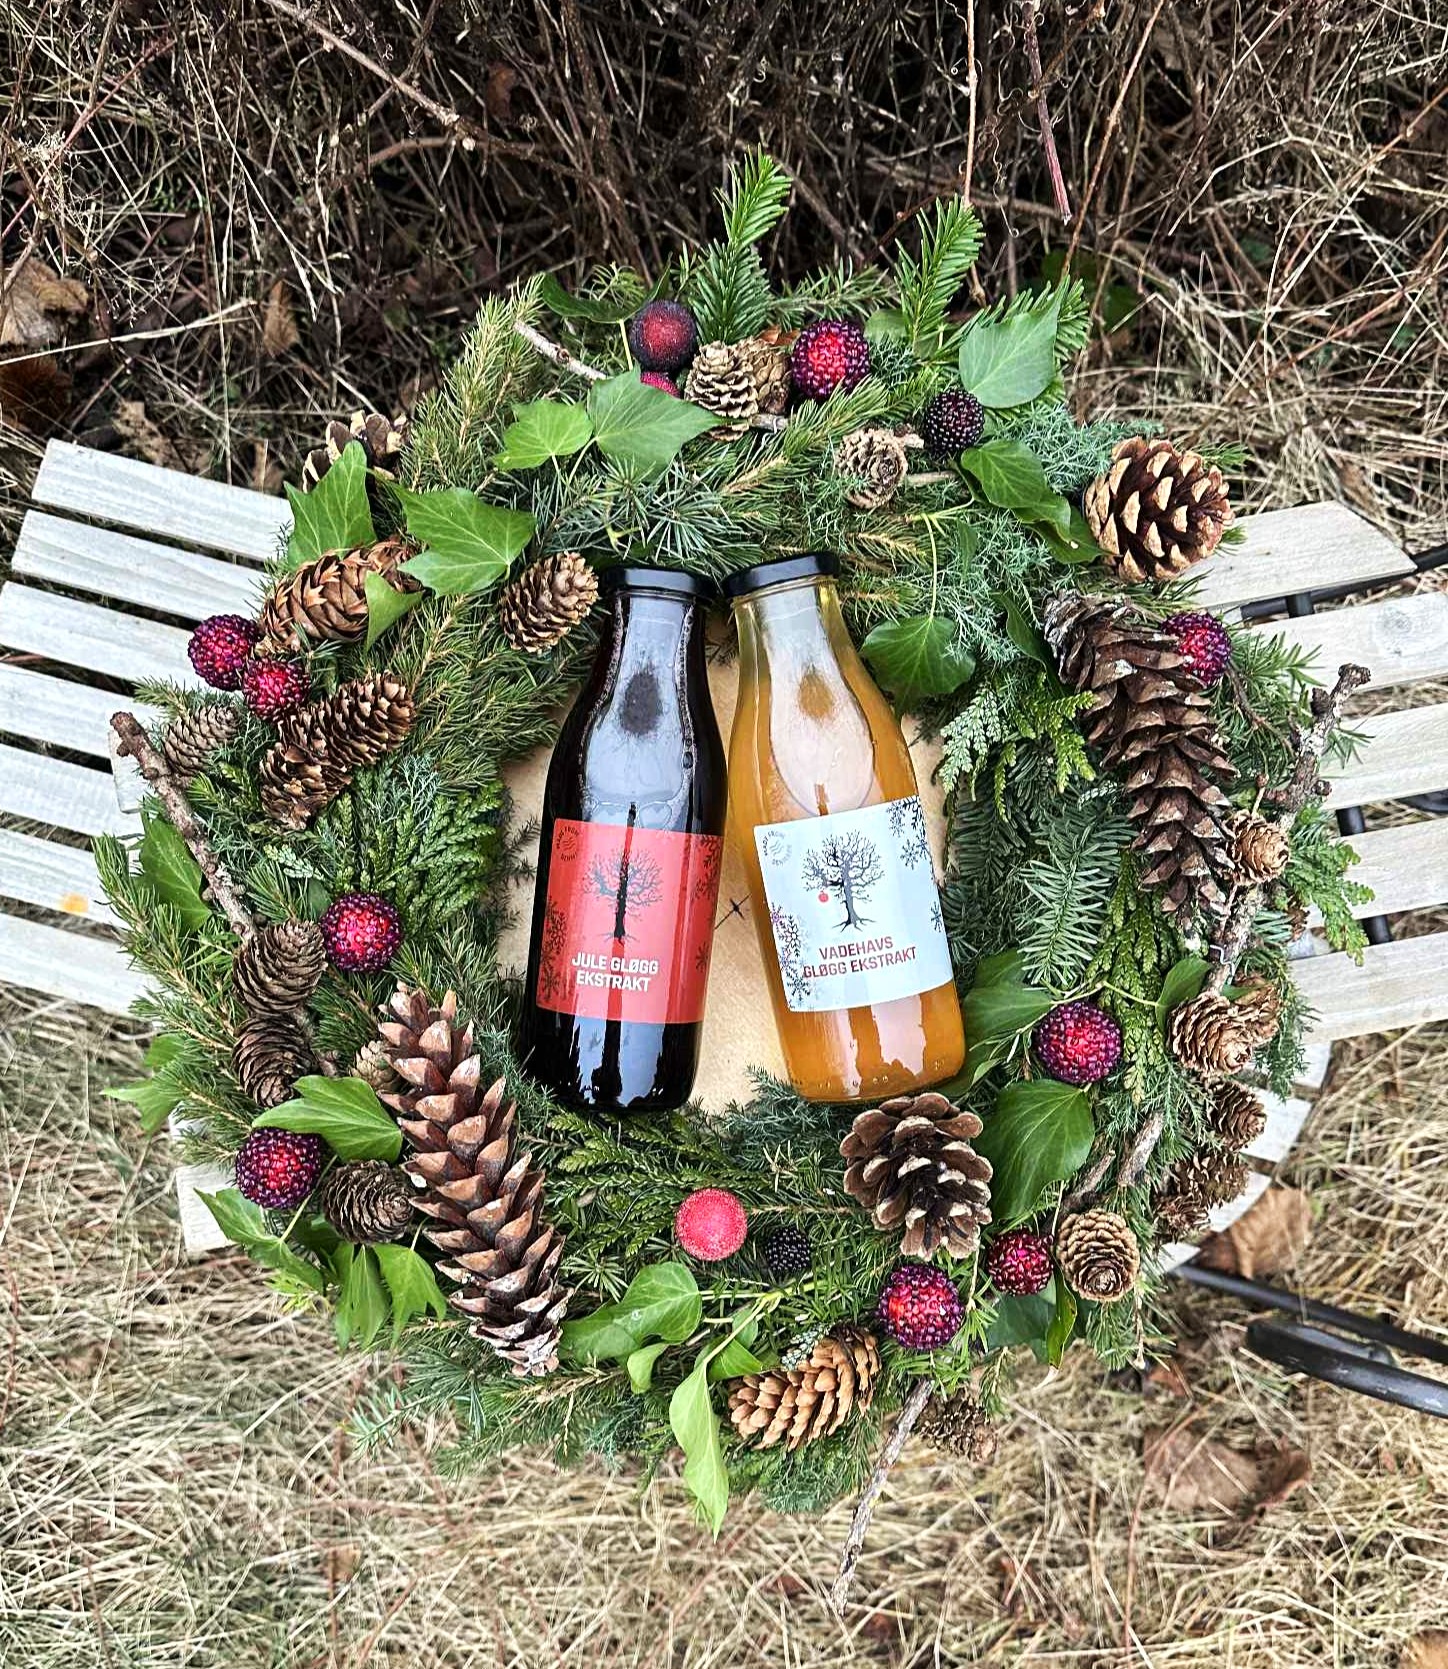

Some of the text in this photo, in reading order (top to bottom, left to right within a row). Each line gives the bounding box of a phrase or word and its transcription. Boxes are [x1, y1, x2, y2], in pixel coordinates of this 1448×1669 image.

[818, 935, 894, 961] VADEHAVS
[571, 951, 659, 975] JULE GLØGG
[802, 946, 917, 979] GLØGG EKSTRAKT
[575, 969, 652, 993] EKSTRAKT
